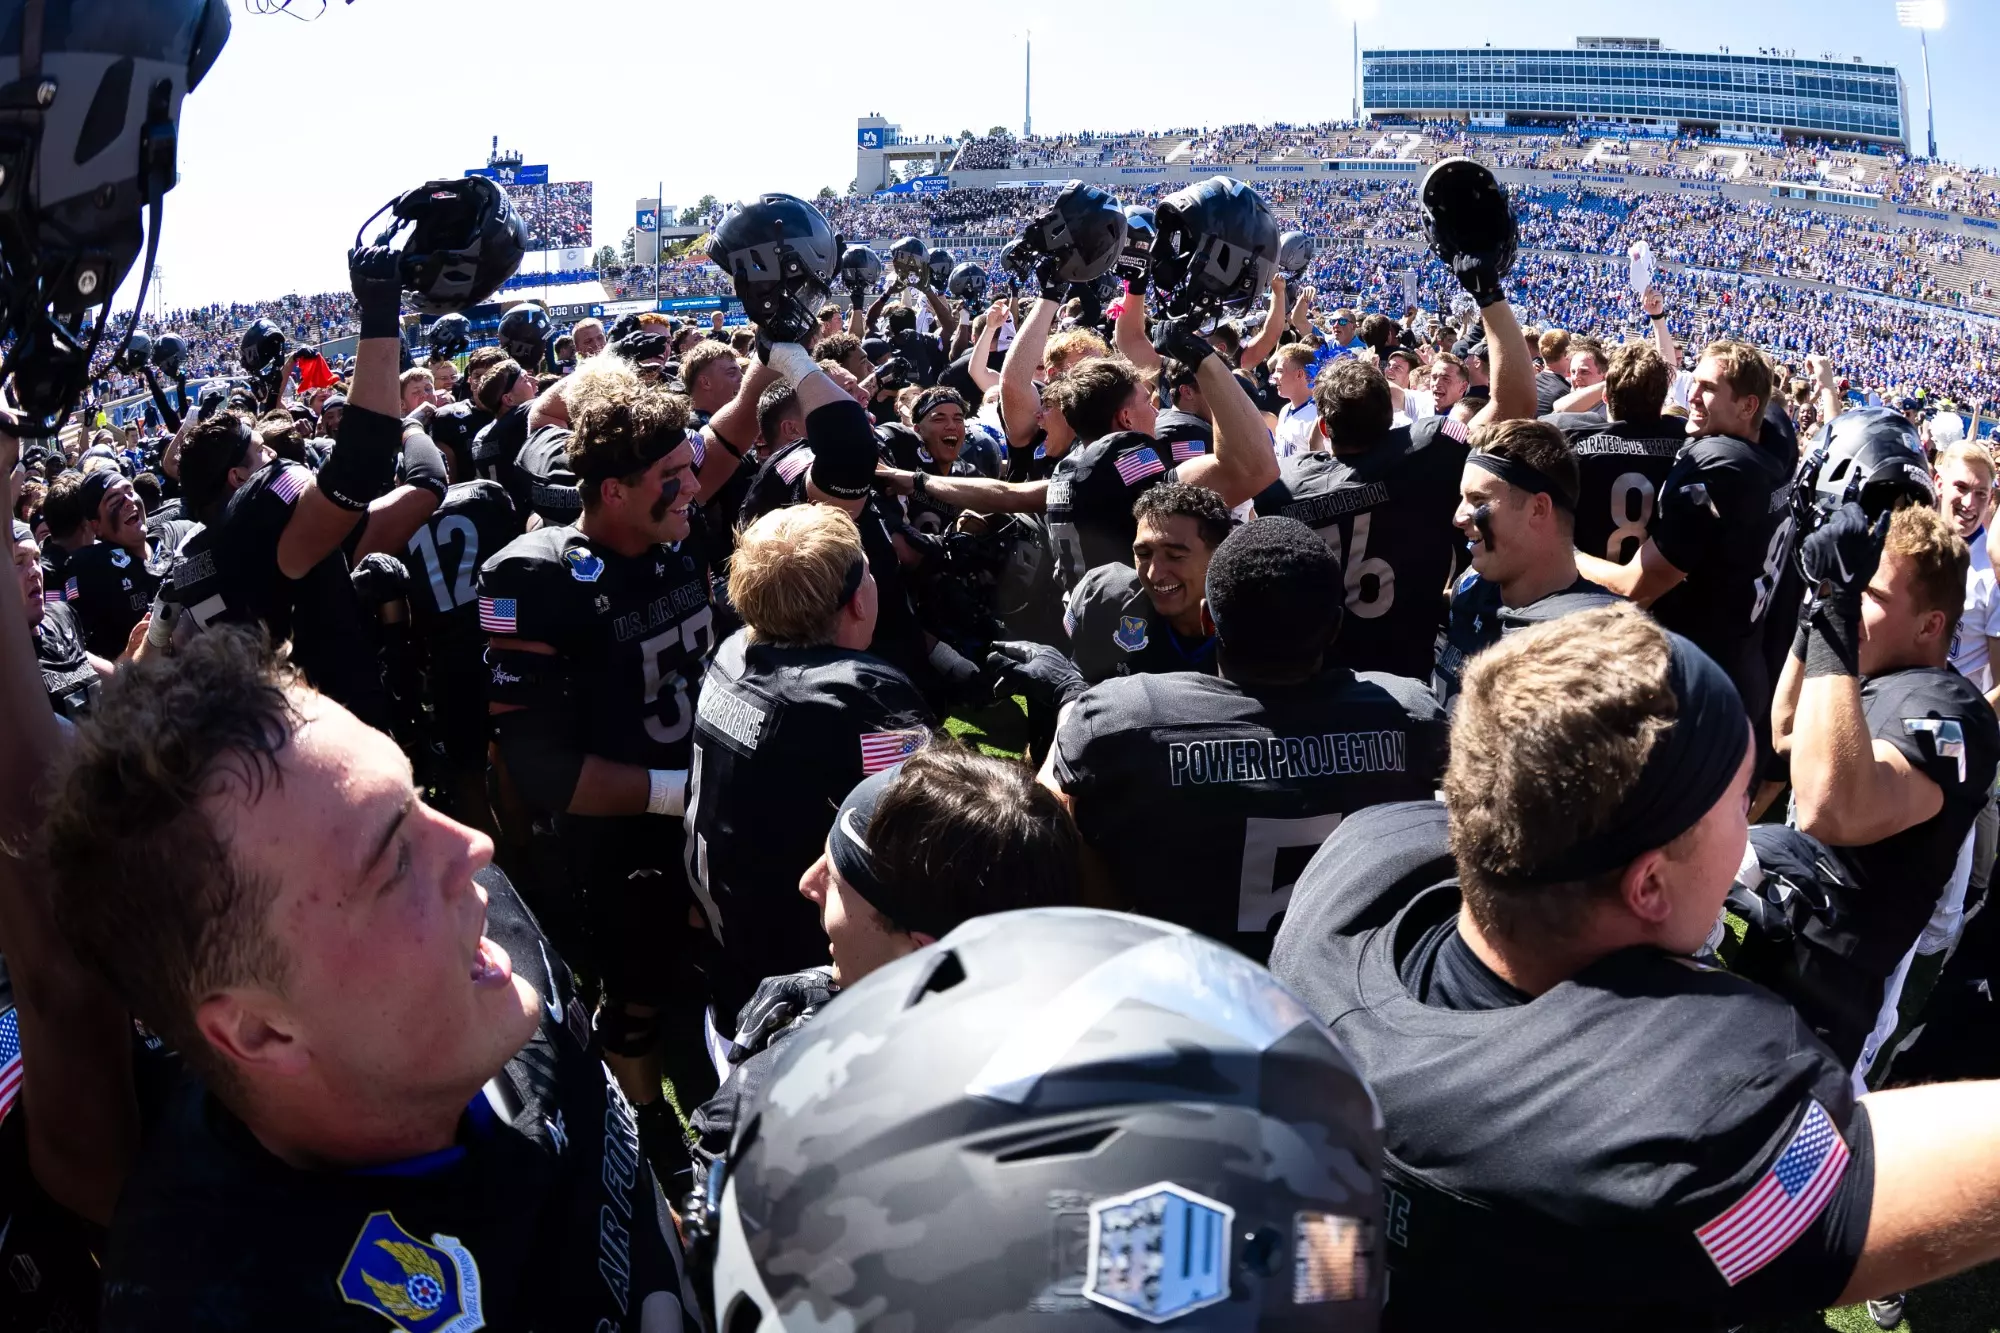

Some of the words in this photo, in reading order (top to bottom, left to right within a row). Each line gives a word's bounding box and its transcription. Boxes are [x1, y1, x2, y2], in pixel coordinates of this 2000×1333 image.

[1552, 172, 1586, 181] MIDNIGHT
[1587, 175, 1625, 184] HAMMER
[1897, 207, 1923, 216] ALLIED
[1923, 210, 1949, 221] FORCE
[1962, 217, 1998, 229] ENDURING
[1313, 481, 1390, 519] PROJECTION
[408, 514, 479, 613] 12
[614, 611, 648, 642] U.S.
[648, 596, 675, 629] AIR
[670, 579, 708, 614] FORCE
[496, 672, 521, 683] Douglas
[1169, 740, 1266, 786] POWER
[1268, 730, 1406, 779] PROJECTION
[453, 1247, 477, 1294] COMMAND
[598, 1203, 632, 1316] AIR
